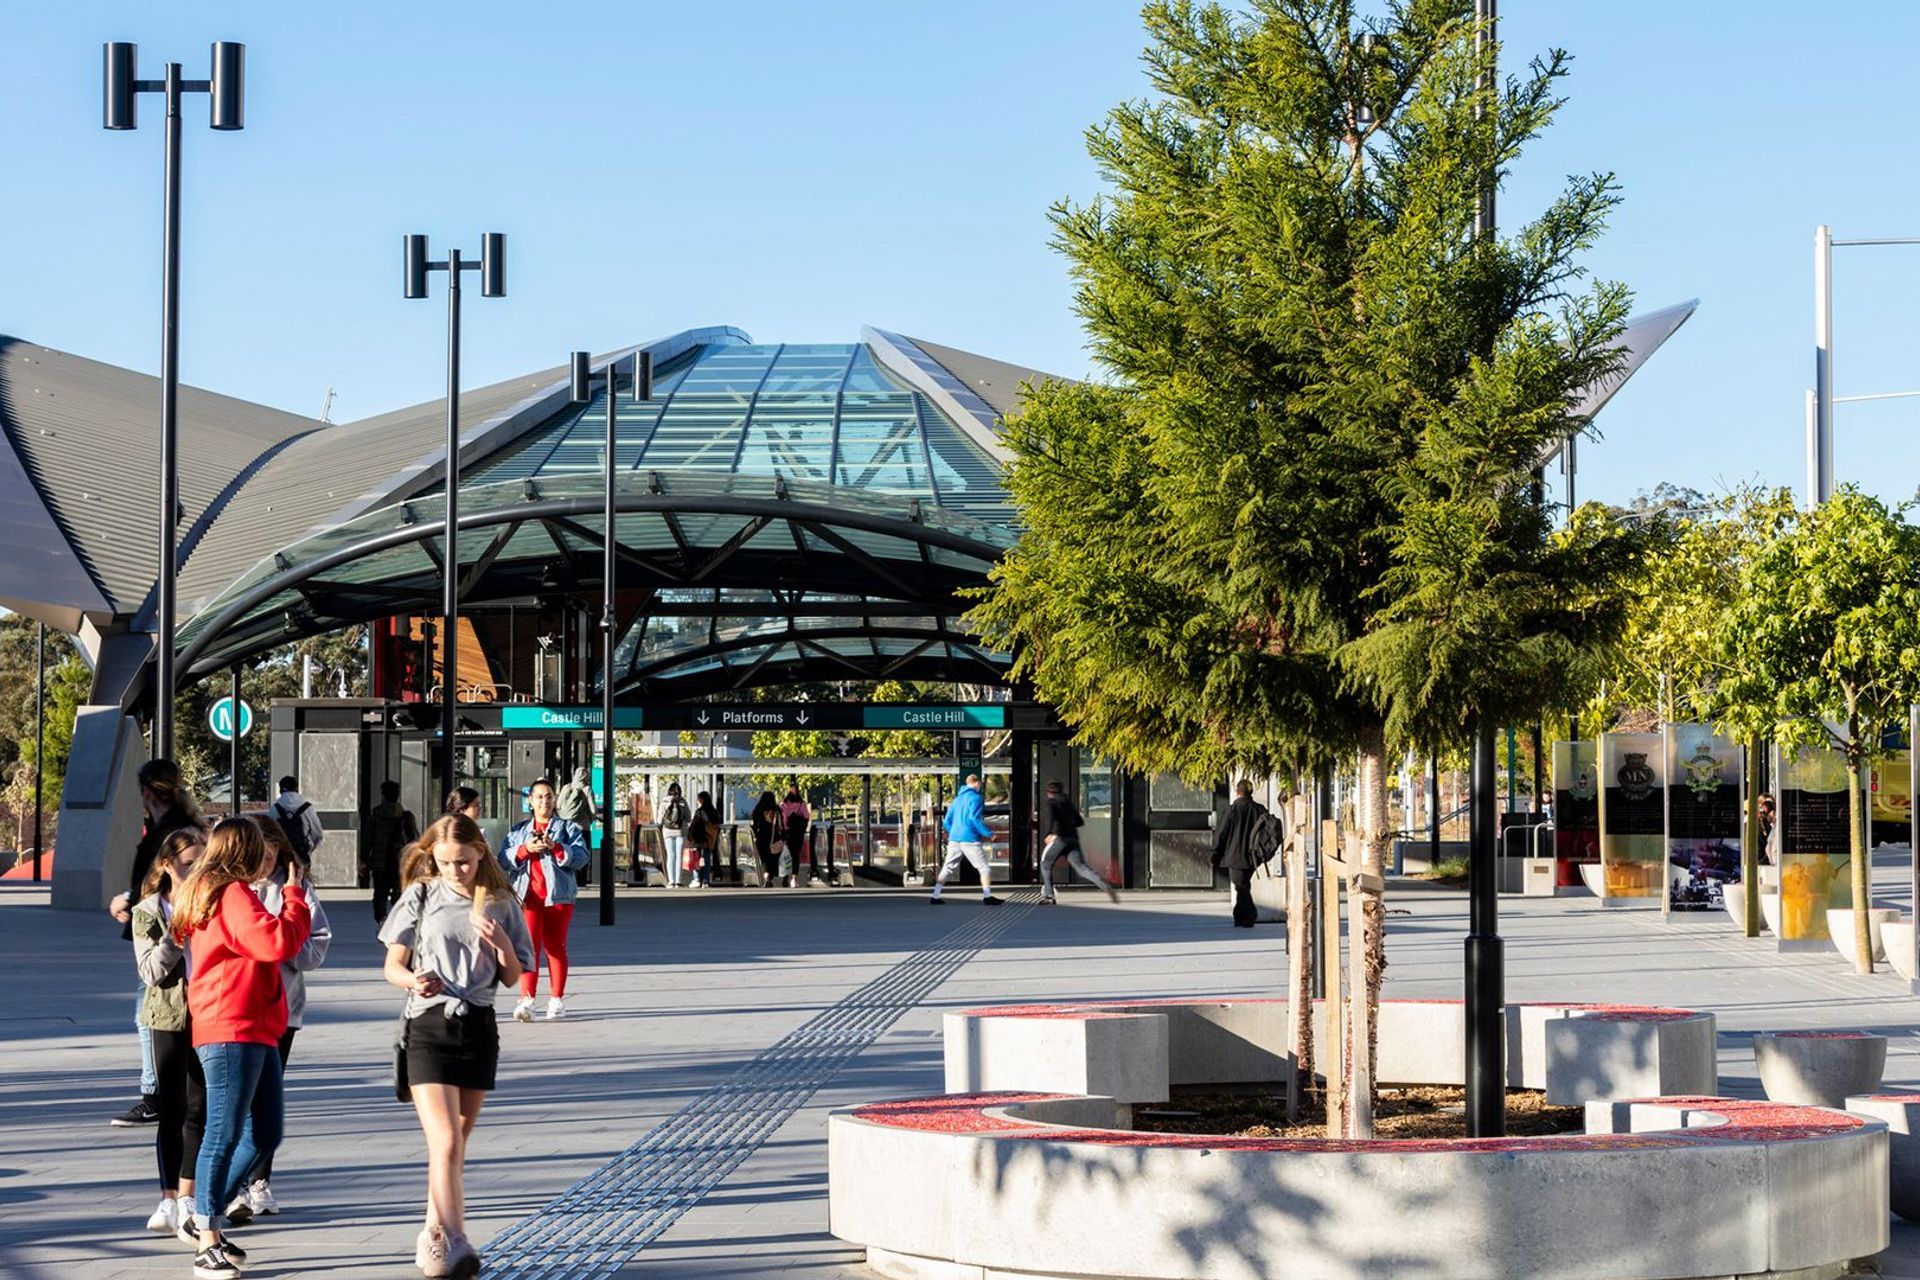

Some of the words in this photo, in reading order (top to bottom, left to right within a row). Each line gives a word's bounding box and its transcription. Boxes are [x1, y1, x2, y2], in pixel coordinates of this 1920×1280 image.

[541, 711, 580, 724] Castle
[583, 711, 604, 723] Hill
[722, 711, 784, 724] Platforms
[903, 711, 942, 723] Castle
[944, 711, 965, 723] Hill
